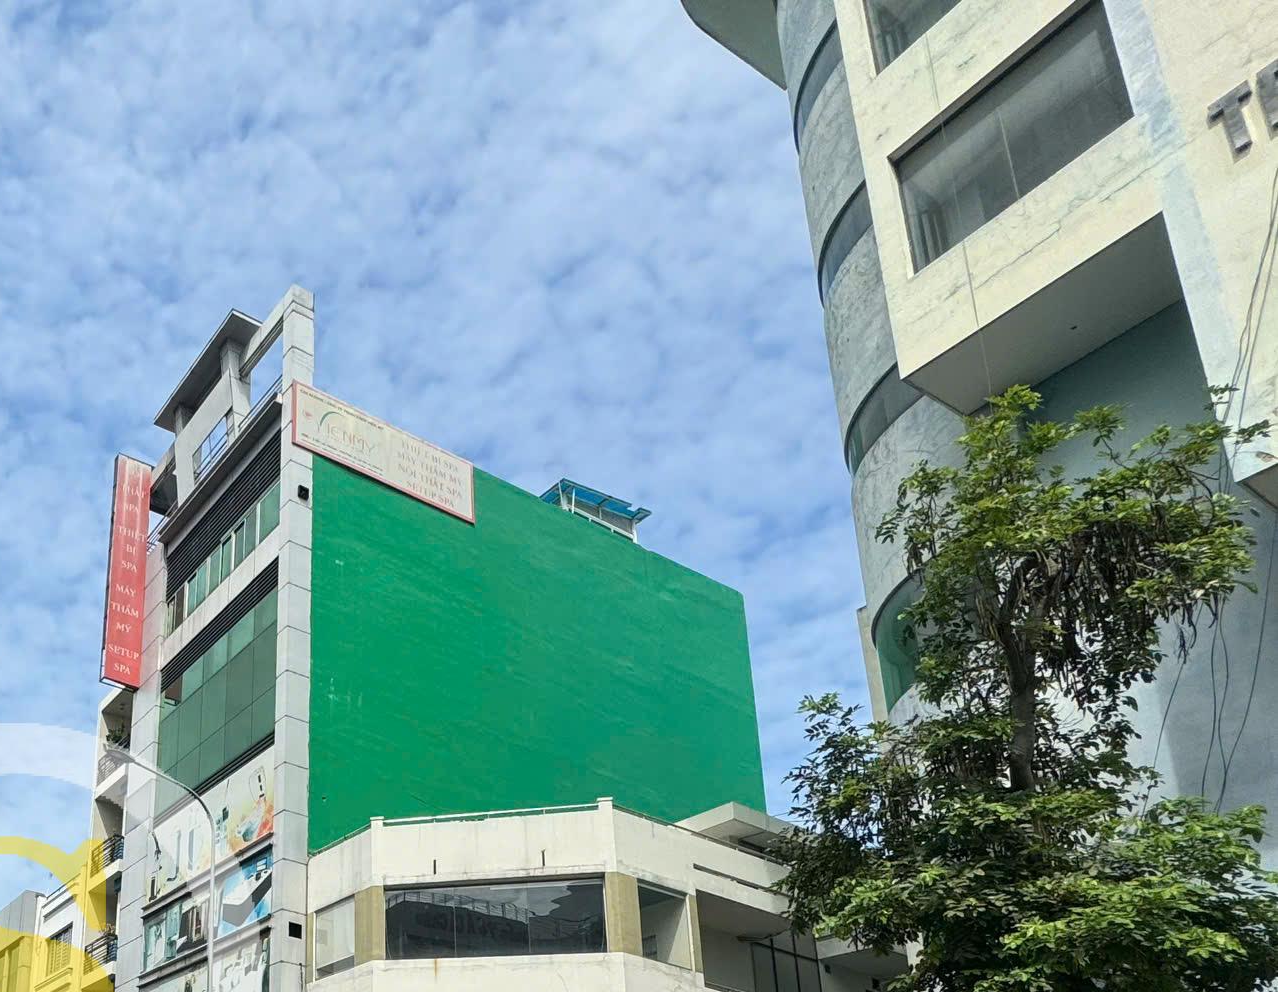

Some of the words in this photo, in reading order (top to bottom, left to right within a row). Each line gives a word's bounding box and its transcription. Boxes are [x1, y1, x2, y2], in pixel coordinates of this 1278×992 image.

[121, 560, 138, 573] SPA
[108, 643, 140, 660] SETUP
[113, 662, 131, 675] SPA
